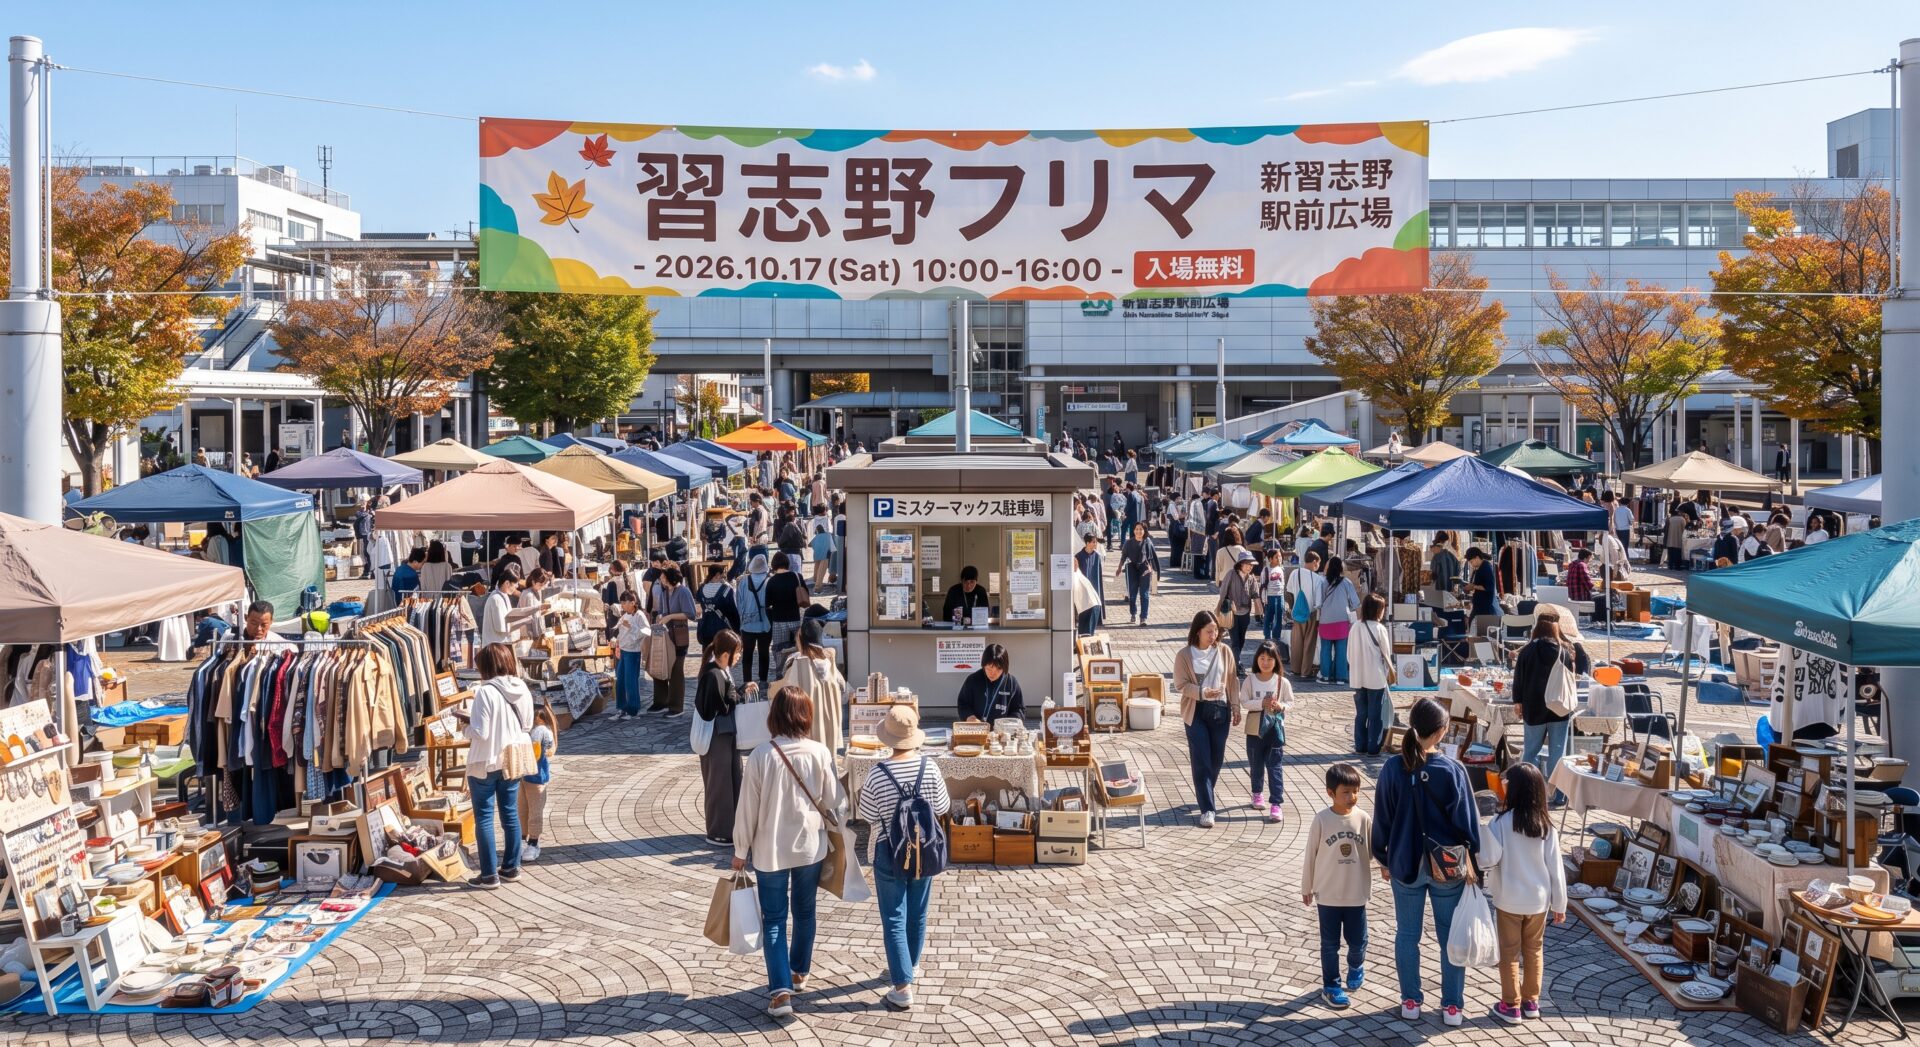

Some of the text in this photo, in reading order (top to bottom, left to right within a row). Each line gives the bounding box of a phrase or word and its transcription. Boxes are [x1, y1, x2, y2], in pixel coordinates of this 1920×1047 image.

[1260, 158, 1394, 193] 新習志野
[636, 152, 1216, 246] 習志野フリマ
[1260, 196, 1394, 232] 駅前広場
[1145, 255, 1244, 281] 入場無料
[896, 499, 1045, 517] ミスターマックス駐車場
